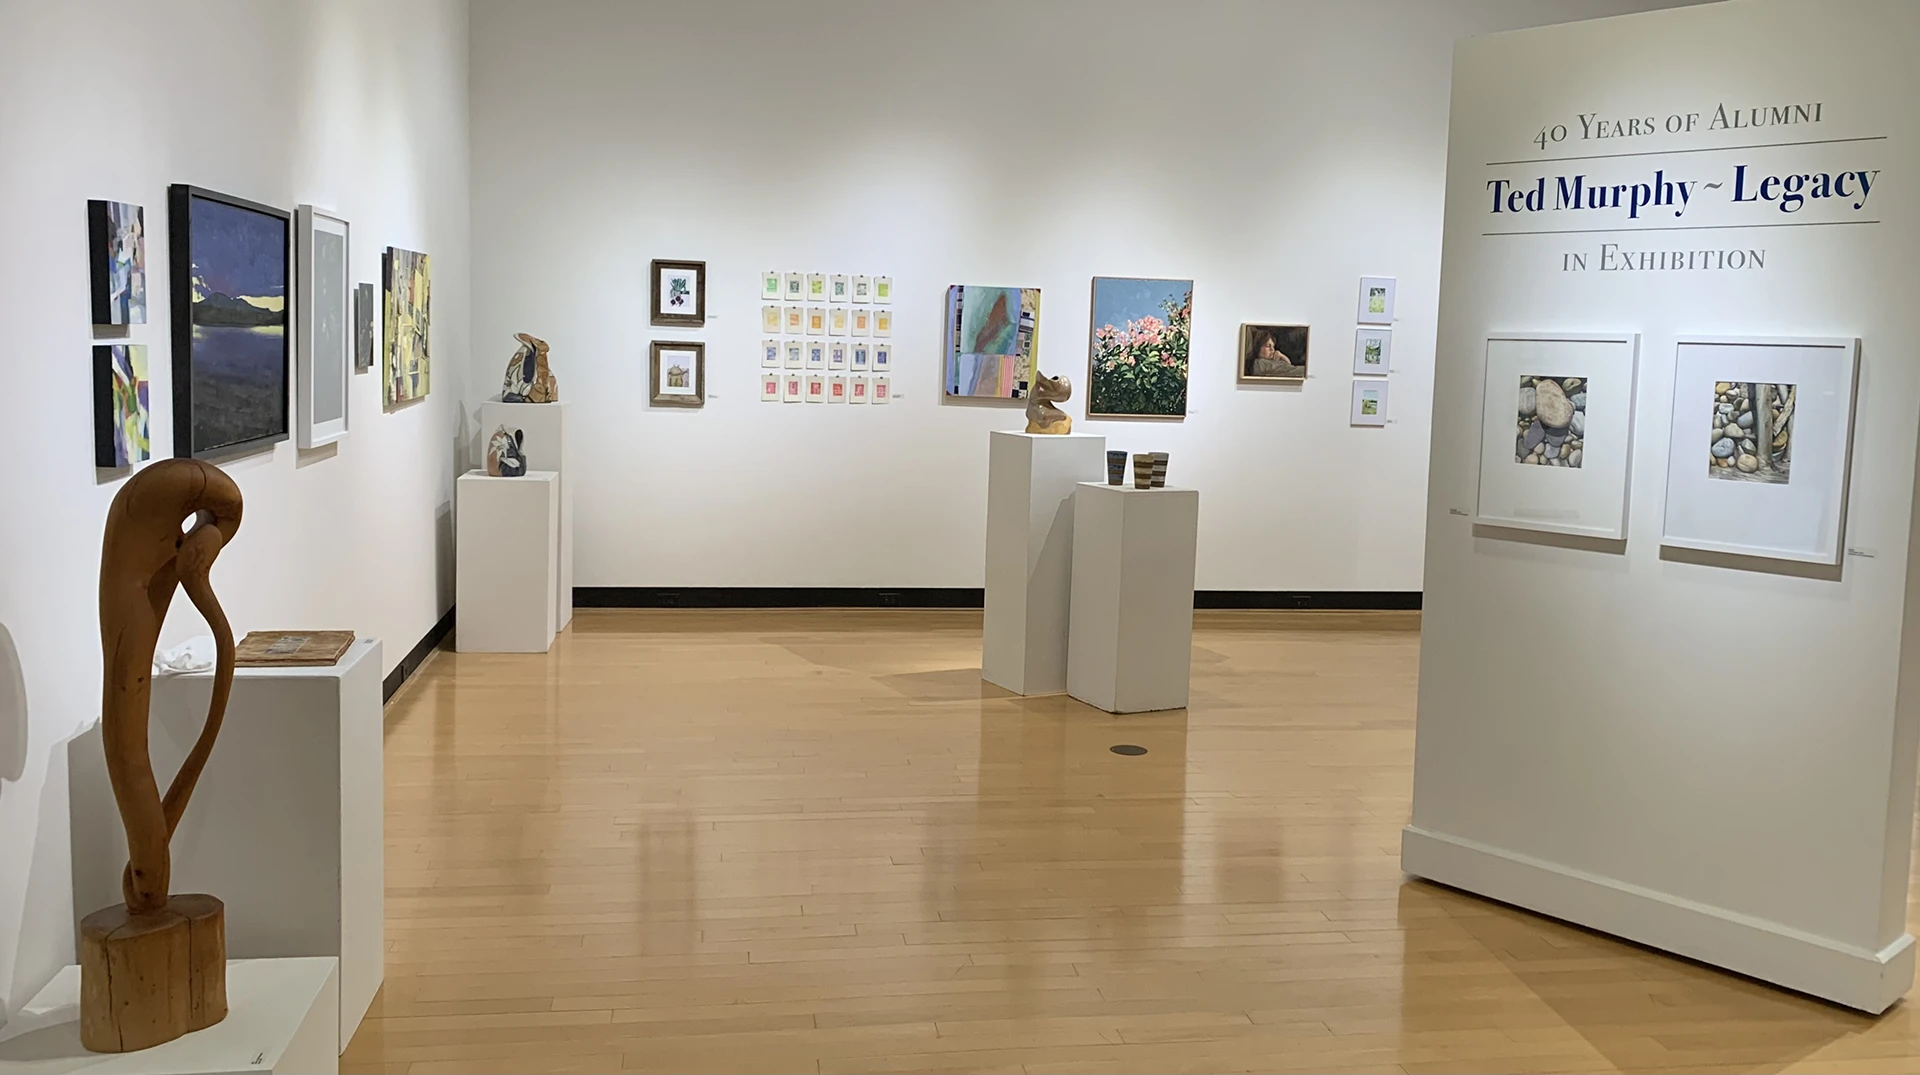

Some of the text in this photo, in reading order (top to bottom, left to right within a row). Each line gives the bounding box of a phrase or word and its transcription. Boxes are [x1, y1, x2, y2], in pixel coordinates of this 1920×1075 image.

[1533, 102, 1823, 151] 40 YEARS OF ALUMNI
[1486, 177, 1546, 214] Ted
[1552, 169, 1698, 219] Murphy
[1730, 164, 1881, 213] Legacy
[1562, 243, 1766, 272] IN EXHIBITION
